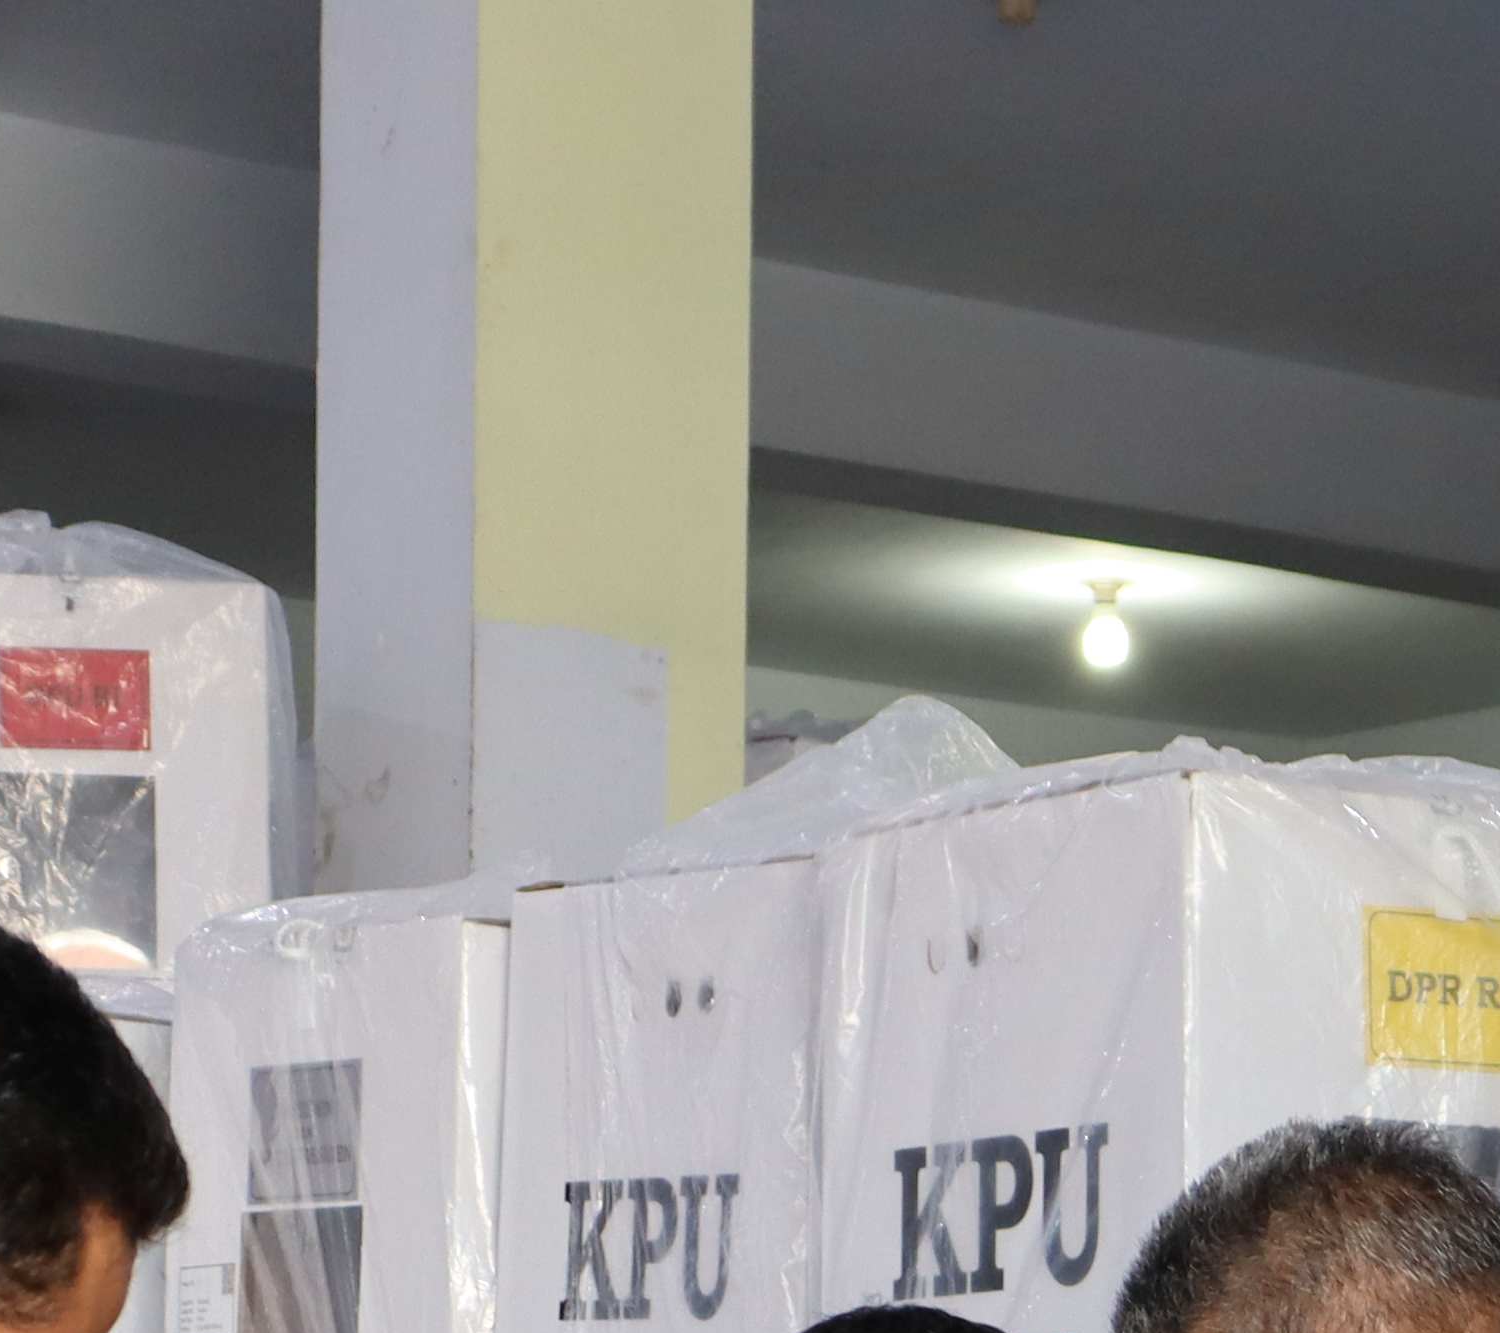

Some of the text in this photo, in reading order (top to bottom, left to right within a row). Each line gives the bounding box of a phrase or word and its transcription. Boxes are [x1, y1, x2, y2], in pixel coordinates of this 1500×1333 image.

[1387, 969, 1462, 1006] DPR
[558, 1173, 740, 1321] KPU
[891, 1122, 1110, 1301] KPU
